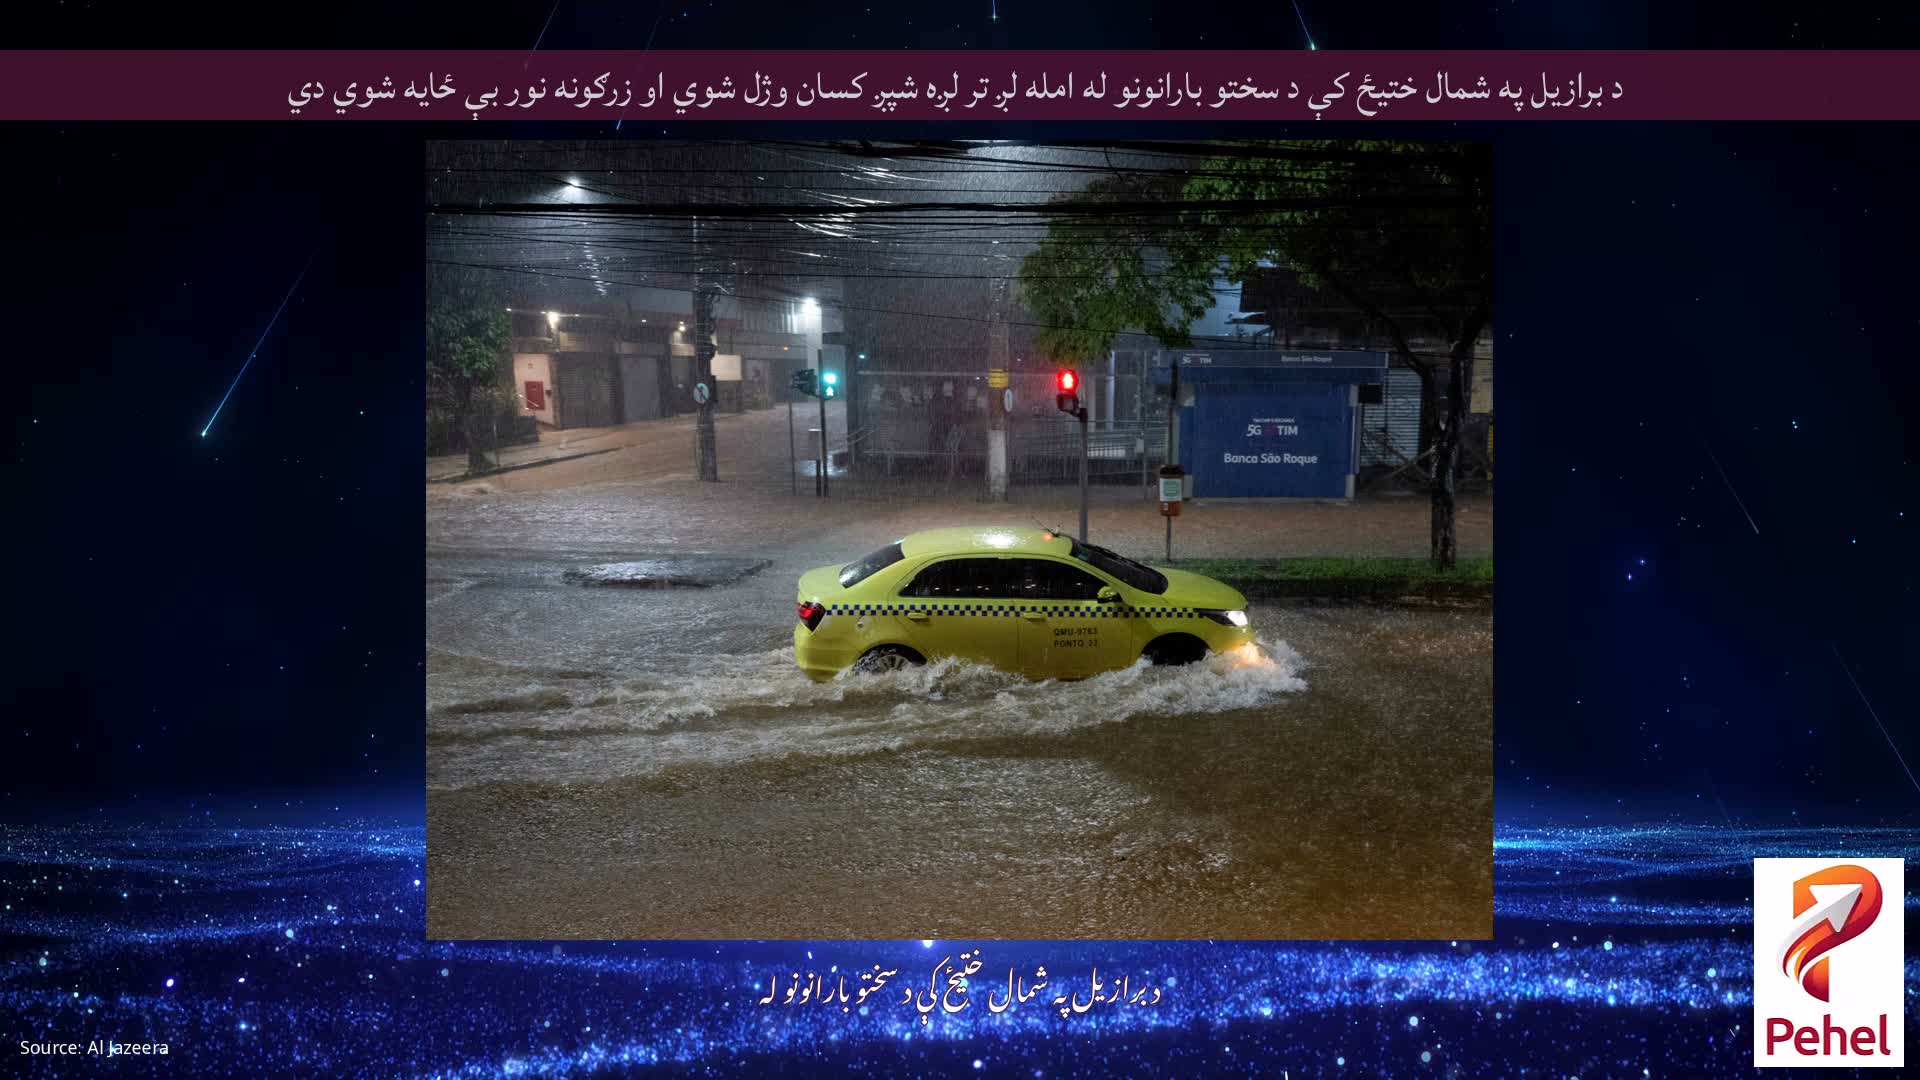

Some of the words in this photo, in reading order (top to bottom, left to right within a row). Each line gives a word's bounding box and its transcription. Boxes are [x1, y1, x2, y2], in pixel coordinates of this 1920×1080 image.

[1246, 424, 1262, 437] 5G
[1277, 425, 1299, 436] TIM
[1223, 452, 1259, 464] Banca
[1260, 452, 1281, 464] São
[1283, 452, 1319, 467] Roque
[1054, 639, 1084, 648] PONTO
